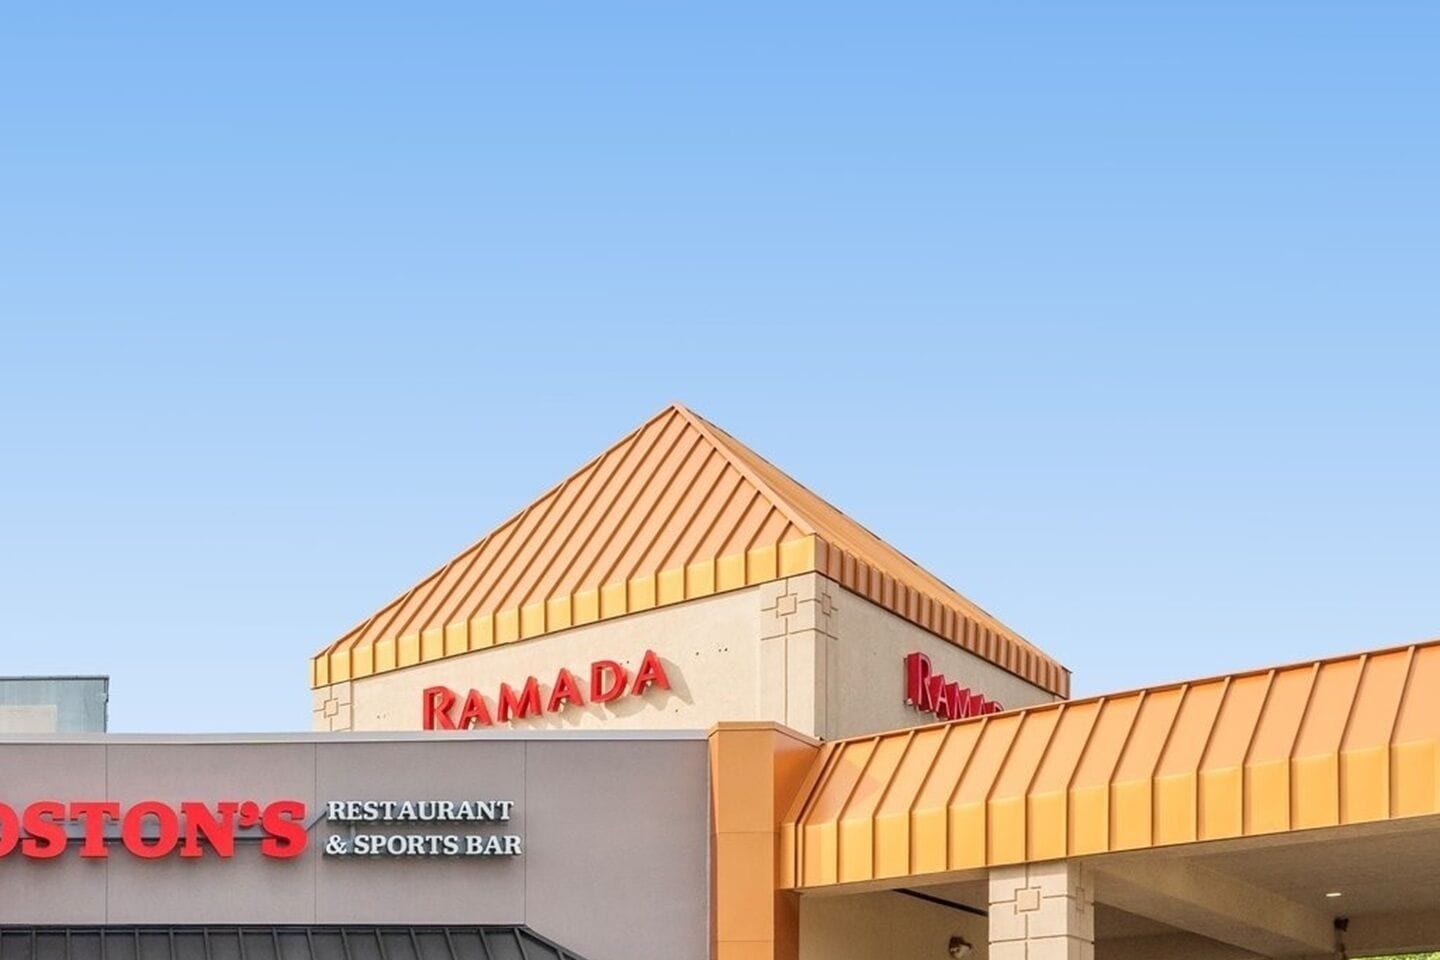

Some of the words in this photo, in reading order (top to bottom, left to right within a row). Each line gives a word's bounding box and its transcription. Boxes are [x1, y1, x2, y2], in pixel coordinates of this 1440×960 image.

[423, 649, 672, 730] RAMADA
[327, 800, 514, 822] RESTAURANT
[325, 834, 347, 855] &
[353, 834, 459, 855] SPORTS
[464, 834, 523, 855] BAR
